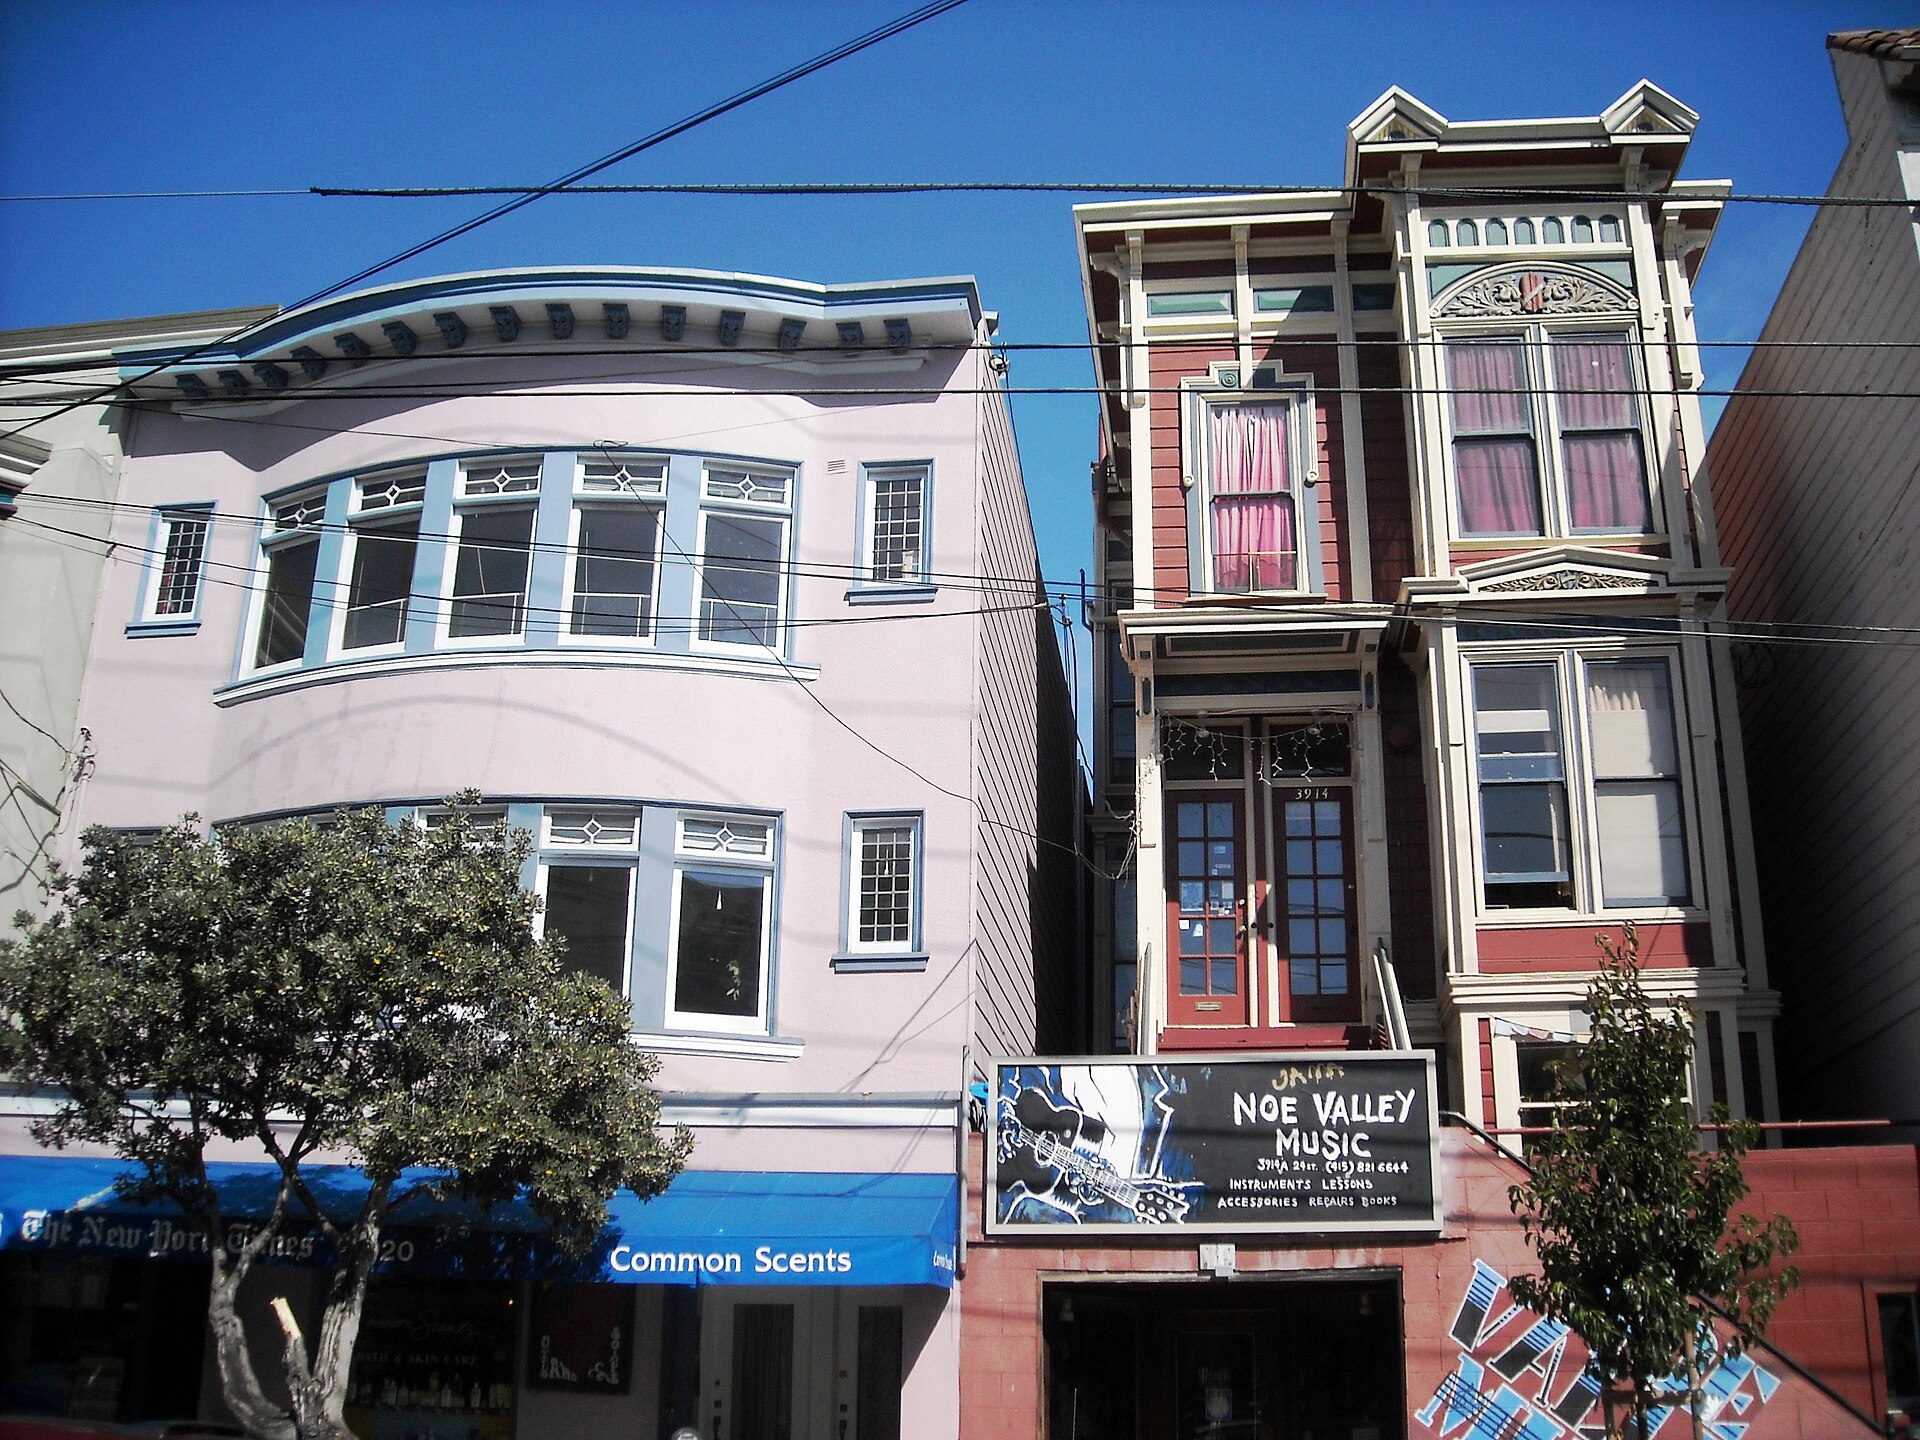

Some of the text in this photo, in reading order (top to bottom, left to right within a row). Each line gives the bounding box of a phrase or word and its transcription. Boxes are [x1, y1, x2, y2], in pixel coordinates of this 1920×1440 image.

[1295, 787, 1329, 800] 3914
[1233, 1088, 1416, 1127] NOE VALLEY
[1275, 1127, 1372, 1161] MUSIC
[1325, 1161, 1354, 1175] (415)
[1356, 1162, 1376, 1174] 821
[1377, 1161, 1410, 1174] 6644
[1229, 1177, 1373, 1191] INSTRUMENTS LESSONS
[1217, 1196, 1398, 1210] ACCESSORIES REPAIRS BOOKS
[22, 1209, 74, 1248] The
[79, 1215, 143, 1249] New
[149, 1218, 215, 1258] Yor
[610, 1246, 852, 1273] Common Scents
[408, 1353, 438, 1365] SKIN
